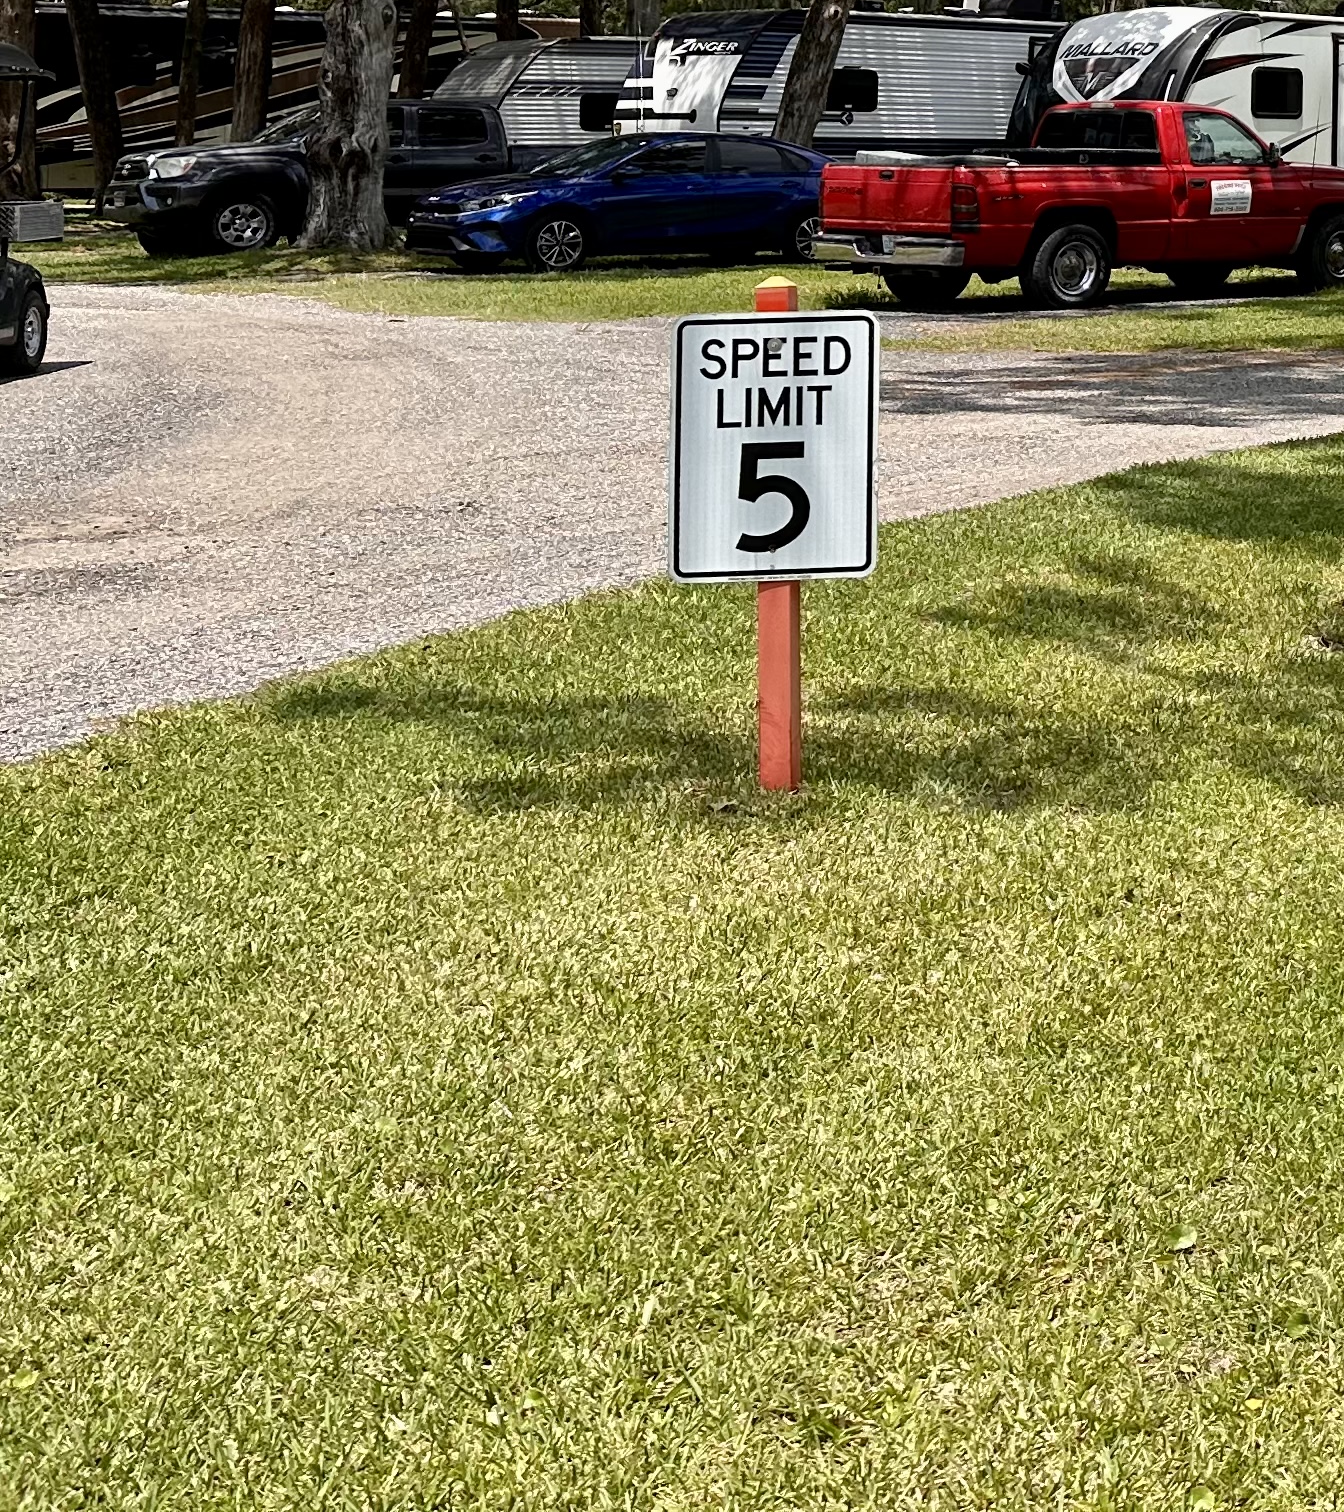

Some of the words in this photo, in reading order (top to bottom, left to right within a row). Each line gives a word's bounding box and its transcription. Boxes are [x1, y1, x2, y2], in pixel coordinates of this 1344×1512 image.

[669, 38, 739, 55] ZINGER
[1059, 41, 1160, 60] MALLARD
[699, 335, 852, 380] SPEED
[716, 385, 833, 429] LIMIT
[735, 440, 811, 553] 5
